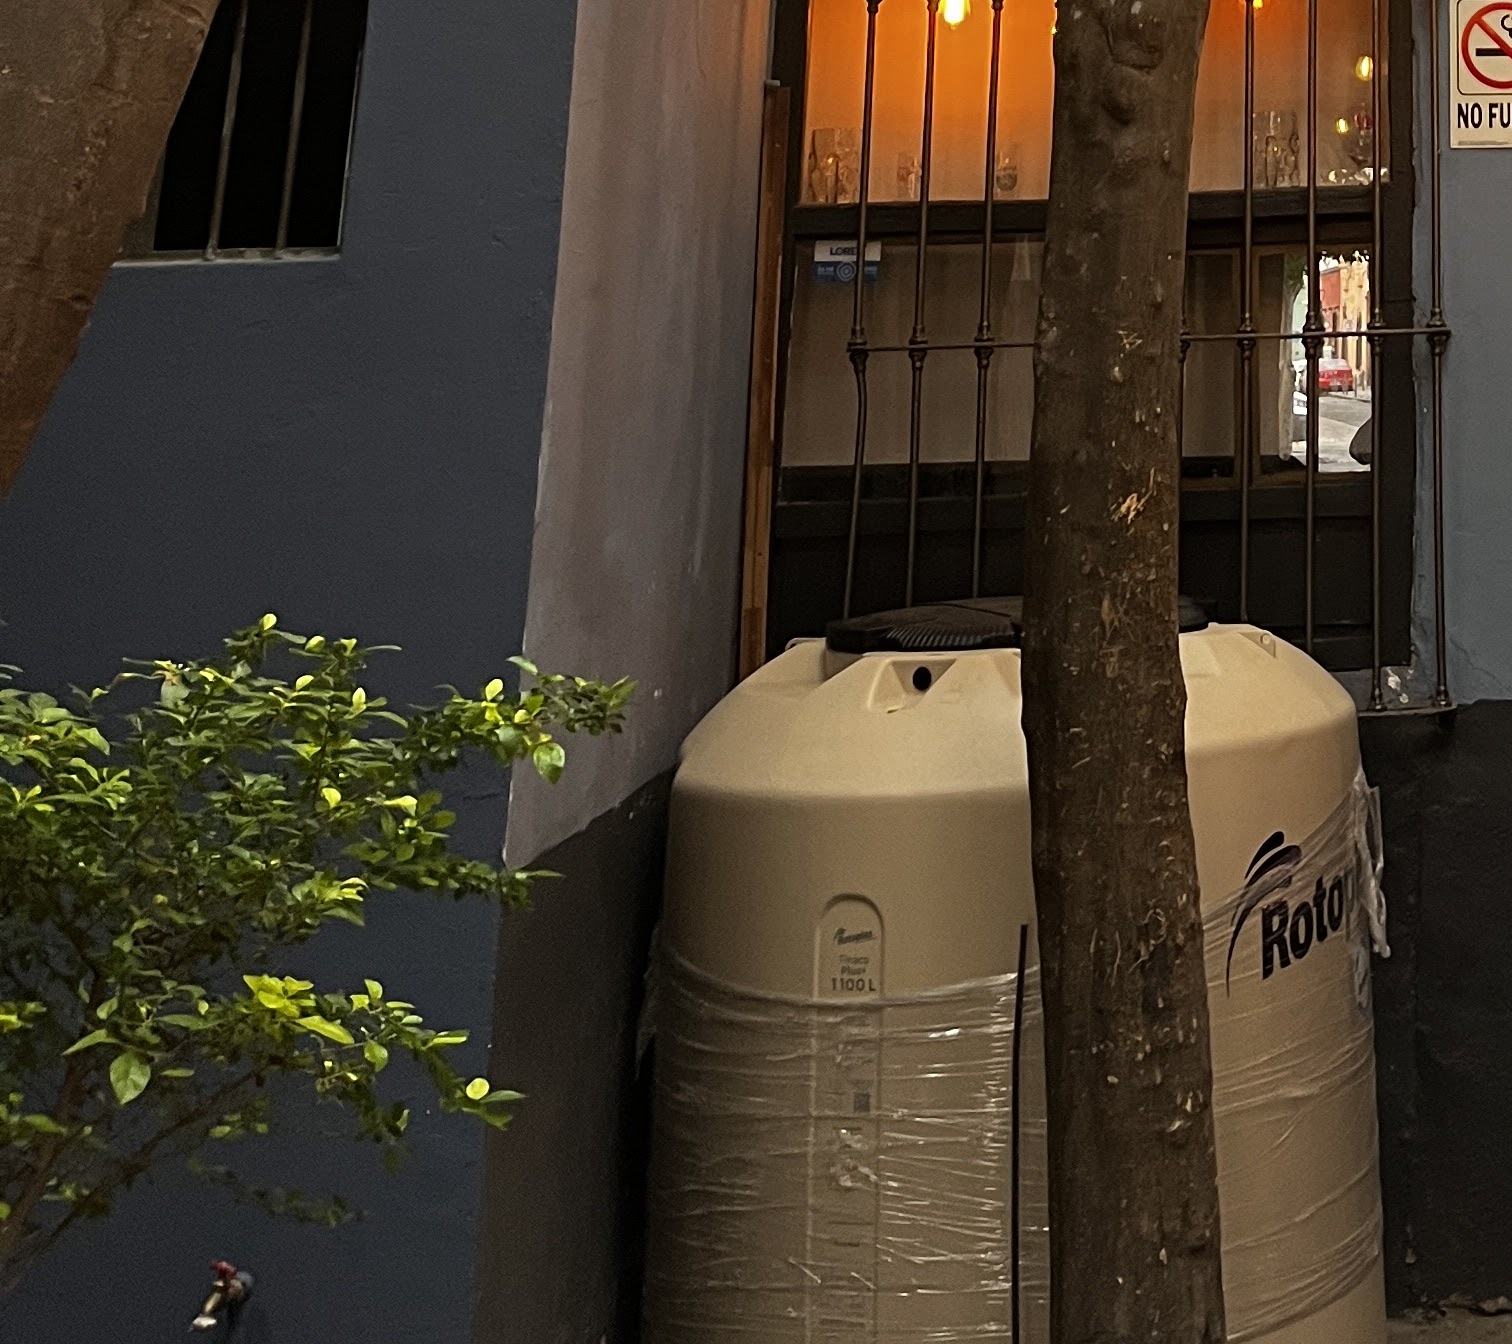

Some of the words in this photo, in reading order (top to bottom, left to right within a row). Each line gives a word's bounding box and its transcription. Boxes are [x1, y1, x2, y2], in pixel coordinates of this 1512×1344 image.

[1457, 102, 1483, 129] NO
[832, 977, 866, 992] 1100
[868, 977, 876, 992] L
